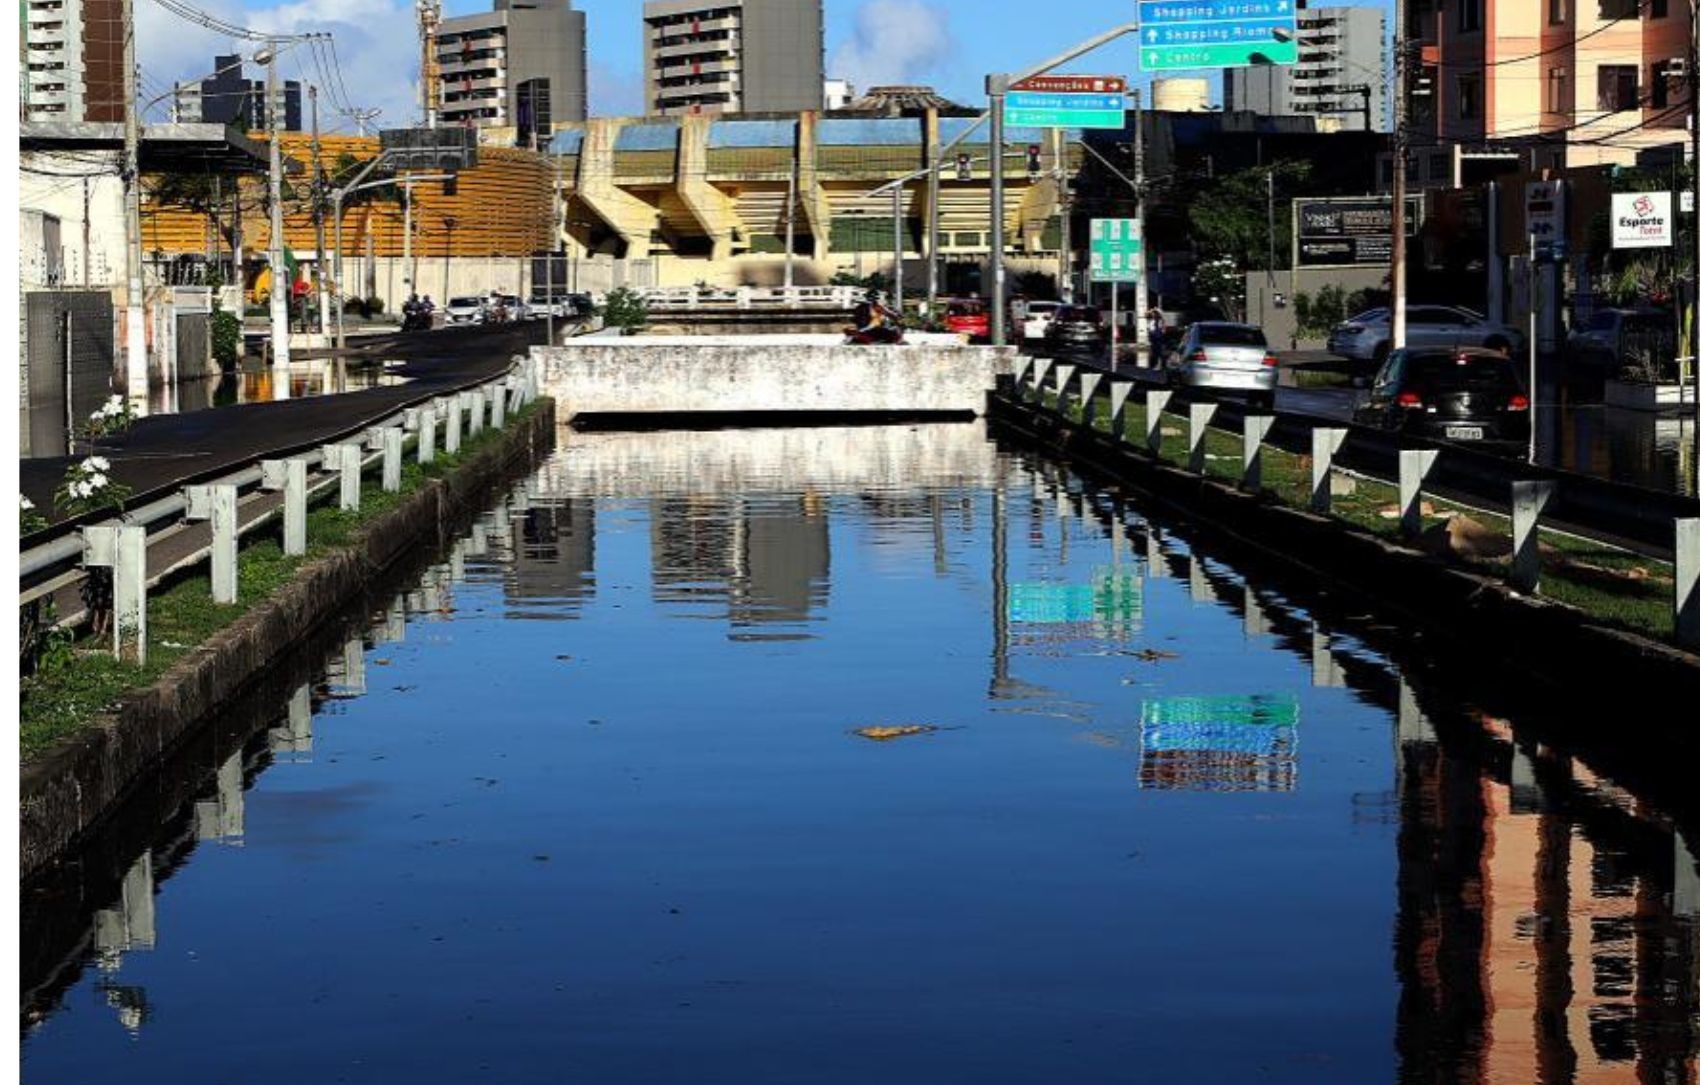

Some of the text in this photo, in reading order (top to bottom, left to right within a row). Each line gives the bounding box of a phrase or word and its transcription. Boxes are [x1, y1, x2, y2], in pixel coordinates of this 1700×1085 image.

[1154, 3, 1271, 17] Shopping Jardins
[1165, 28, 1229, 40] Shopping
[1166, 52, 1211, 63] Centro
[1619, 217, 1664, 228] Esporte
